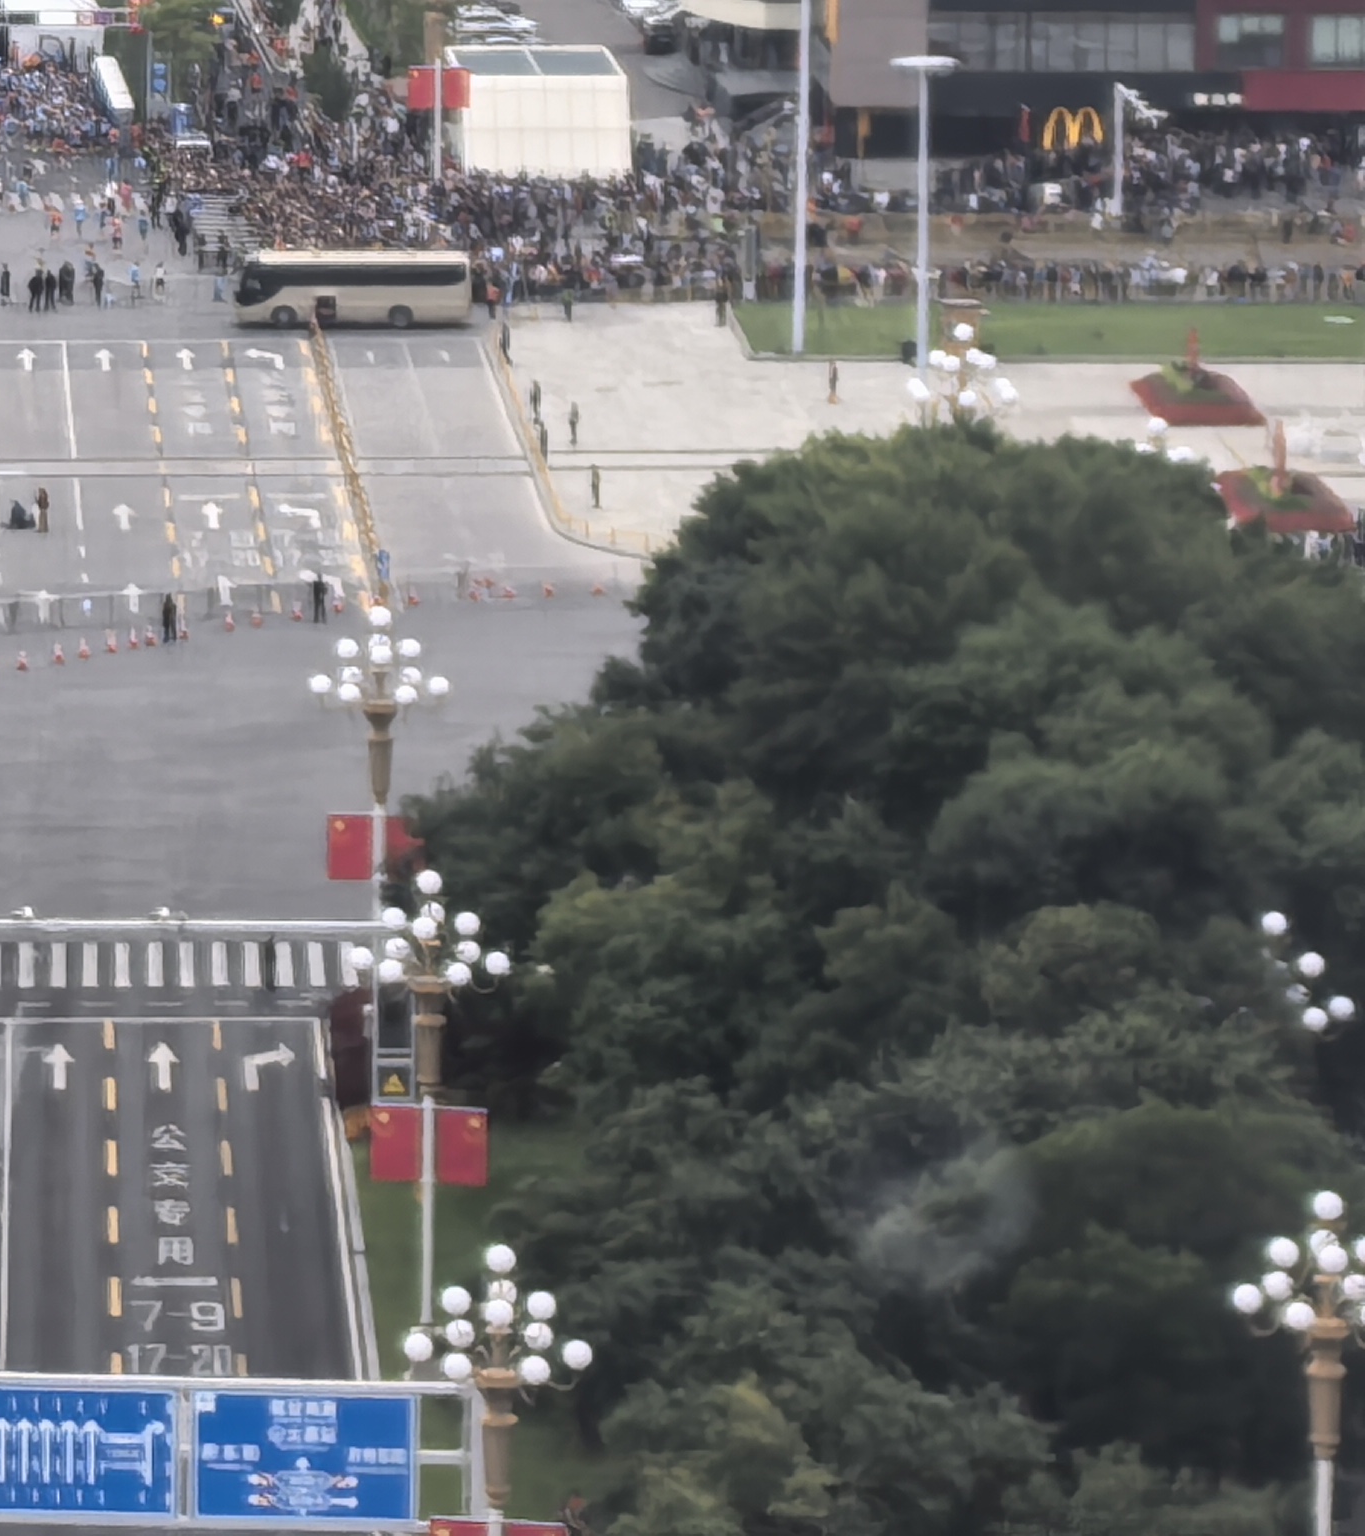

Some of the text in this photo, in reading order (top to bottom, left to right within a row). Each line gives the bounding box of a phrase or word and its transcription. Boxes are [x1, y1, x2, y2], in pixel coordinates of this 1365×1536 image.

[150, 1124, 195, 1266] 公交专用
[130, 1299, 226, 1332] 7-9
[125, 1343, 232, 1375] 17-20
